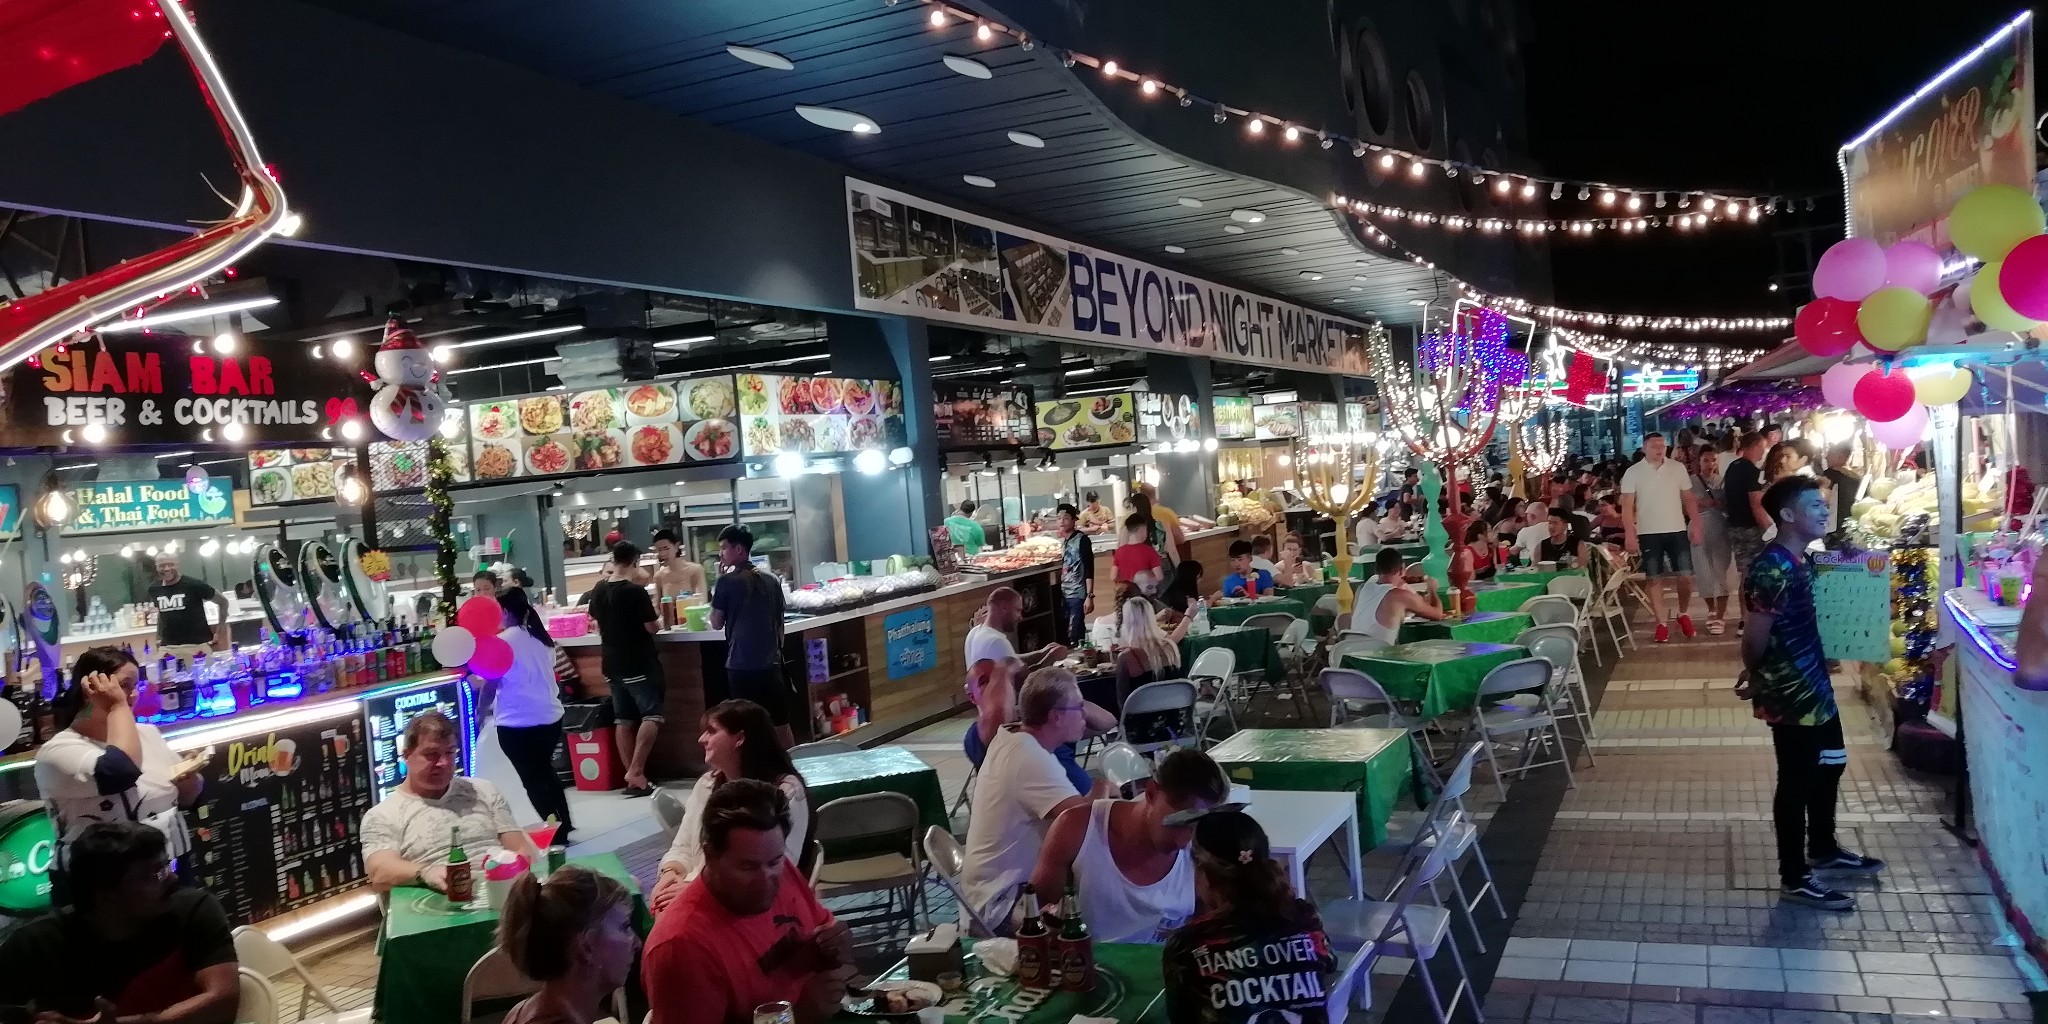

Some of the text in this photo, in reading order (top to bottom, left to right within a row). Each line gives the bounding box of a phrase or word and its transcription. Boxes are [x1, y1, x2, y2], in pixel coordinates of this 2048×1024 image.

[1067, 250, 1353, 369] BEYOND NIGHT MARKET
[41, 348, 275, 395] SIAM BAR
[44, 397, 126, 426] BEER
[138, 399, 163, 426] &
[174, 398, 319, 426] COCKTAILS
[77, 483, 190, 505] Halal Food
[78, 503, 190, 524] & Thai Food
[395, 690, 437, 711] COCKTAILS
[1195, 938, 1318, 977] HANG OVER
[1210, 971, 1326, 1010] COCKTAIL
